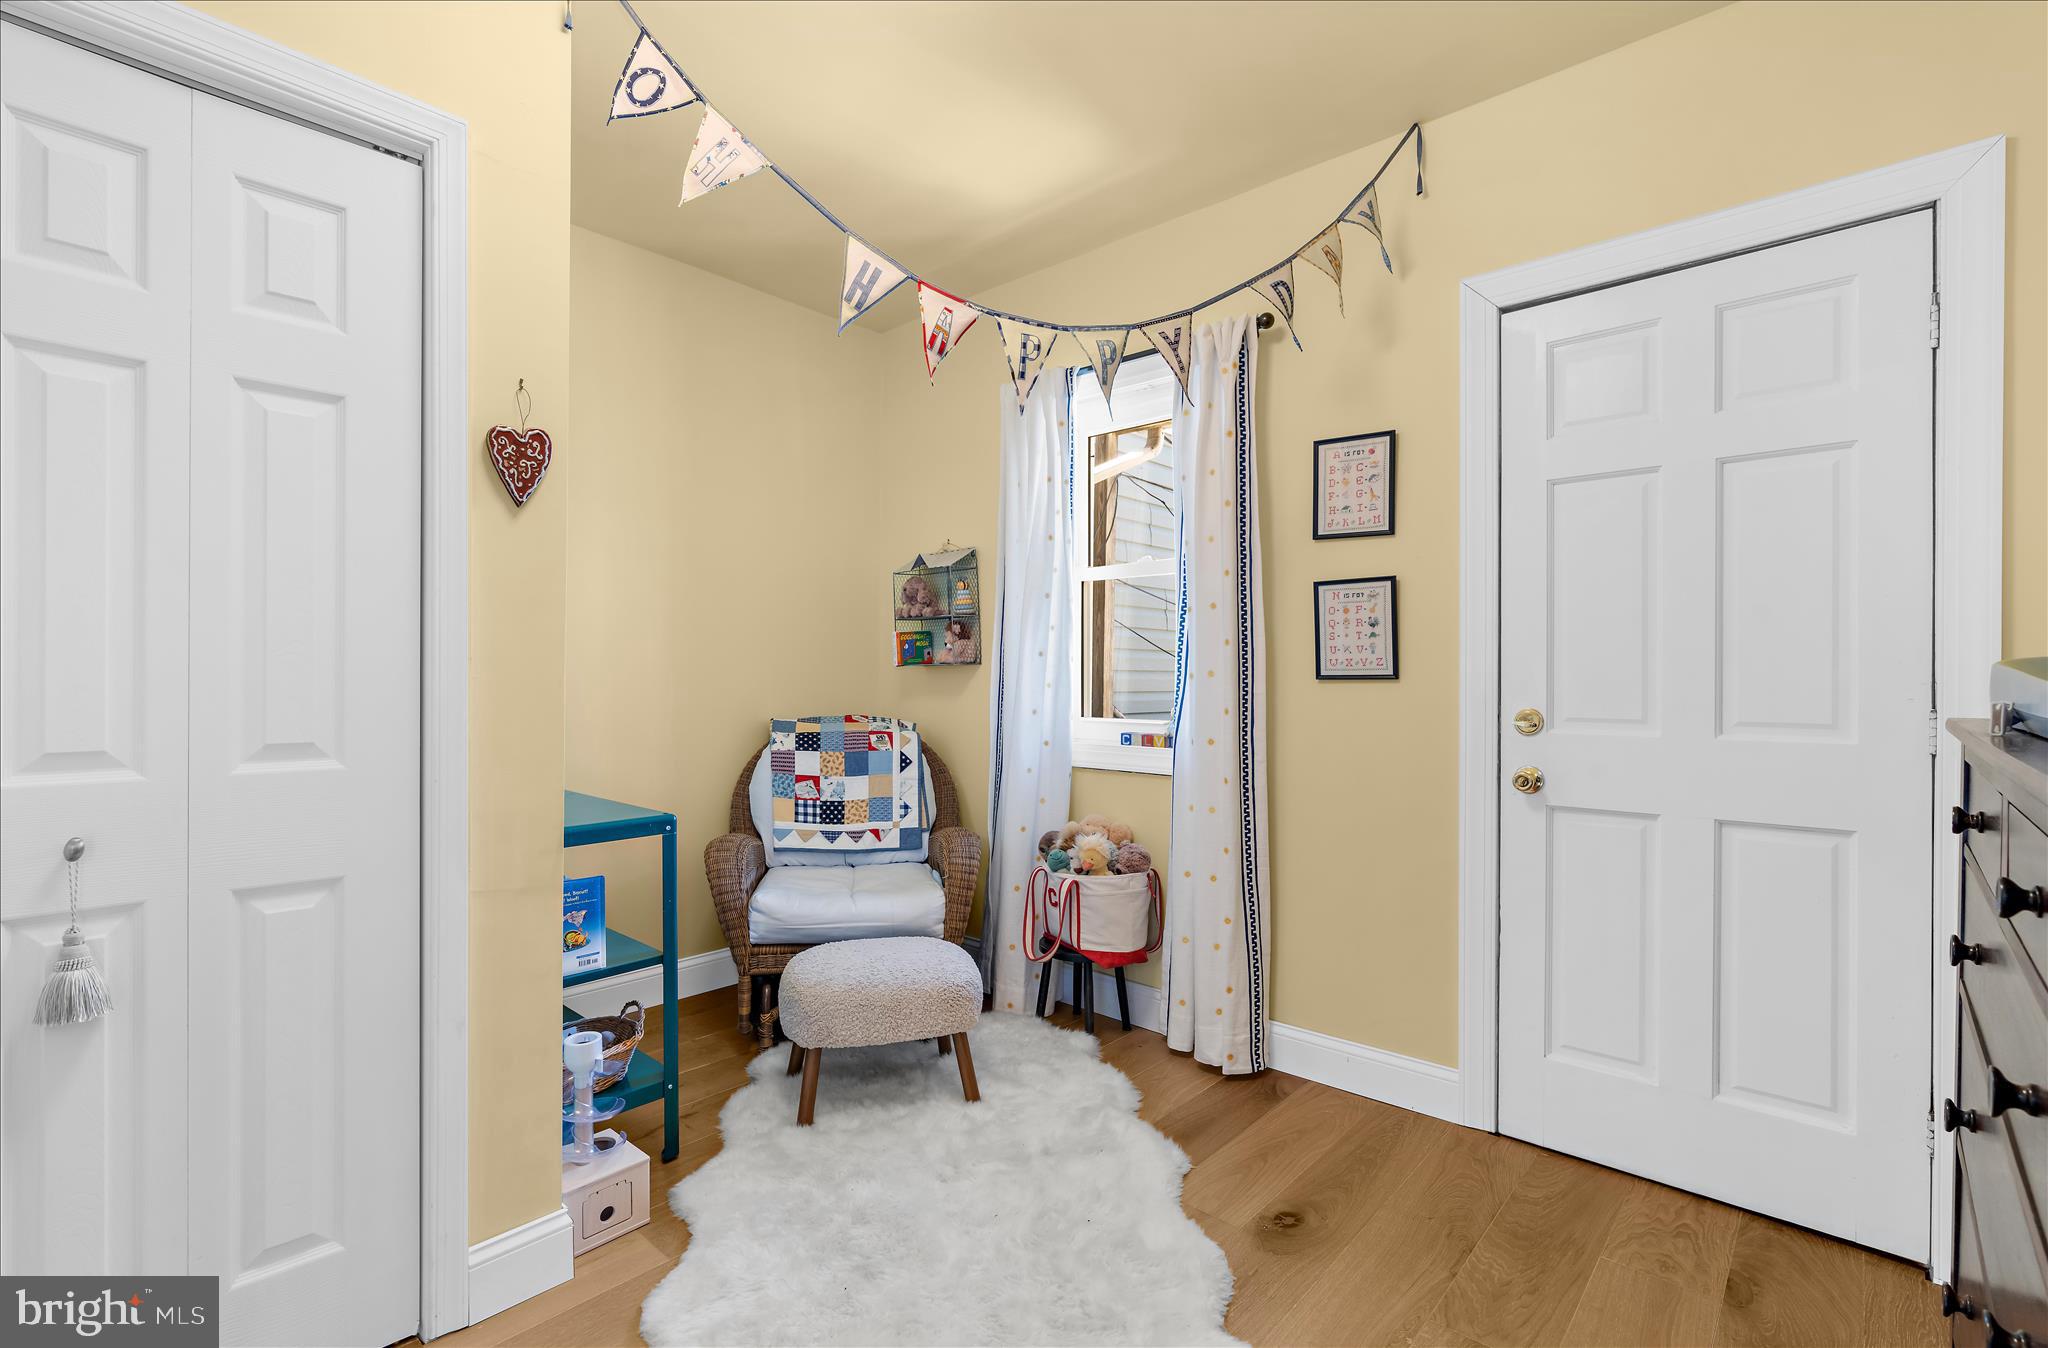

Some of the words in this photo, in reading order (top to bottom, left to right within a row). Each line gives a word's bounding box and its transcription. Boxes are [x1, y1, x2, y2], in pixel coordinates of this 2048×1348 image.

[626, 67, 741, 188] OH
[843, 259, 1182, 385] HAPPY
[1356, 463, 1364, 472] C
[1356, 489, 1364, 498] G
[1329, 506, 1336, 515] H
[1356, 618, 1364, 627] R
[1329, 632, 1336, 641] S
[1376, 657, 1384, 667] Z
[1048, 887, 1059, 908] C
